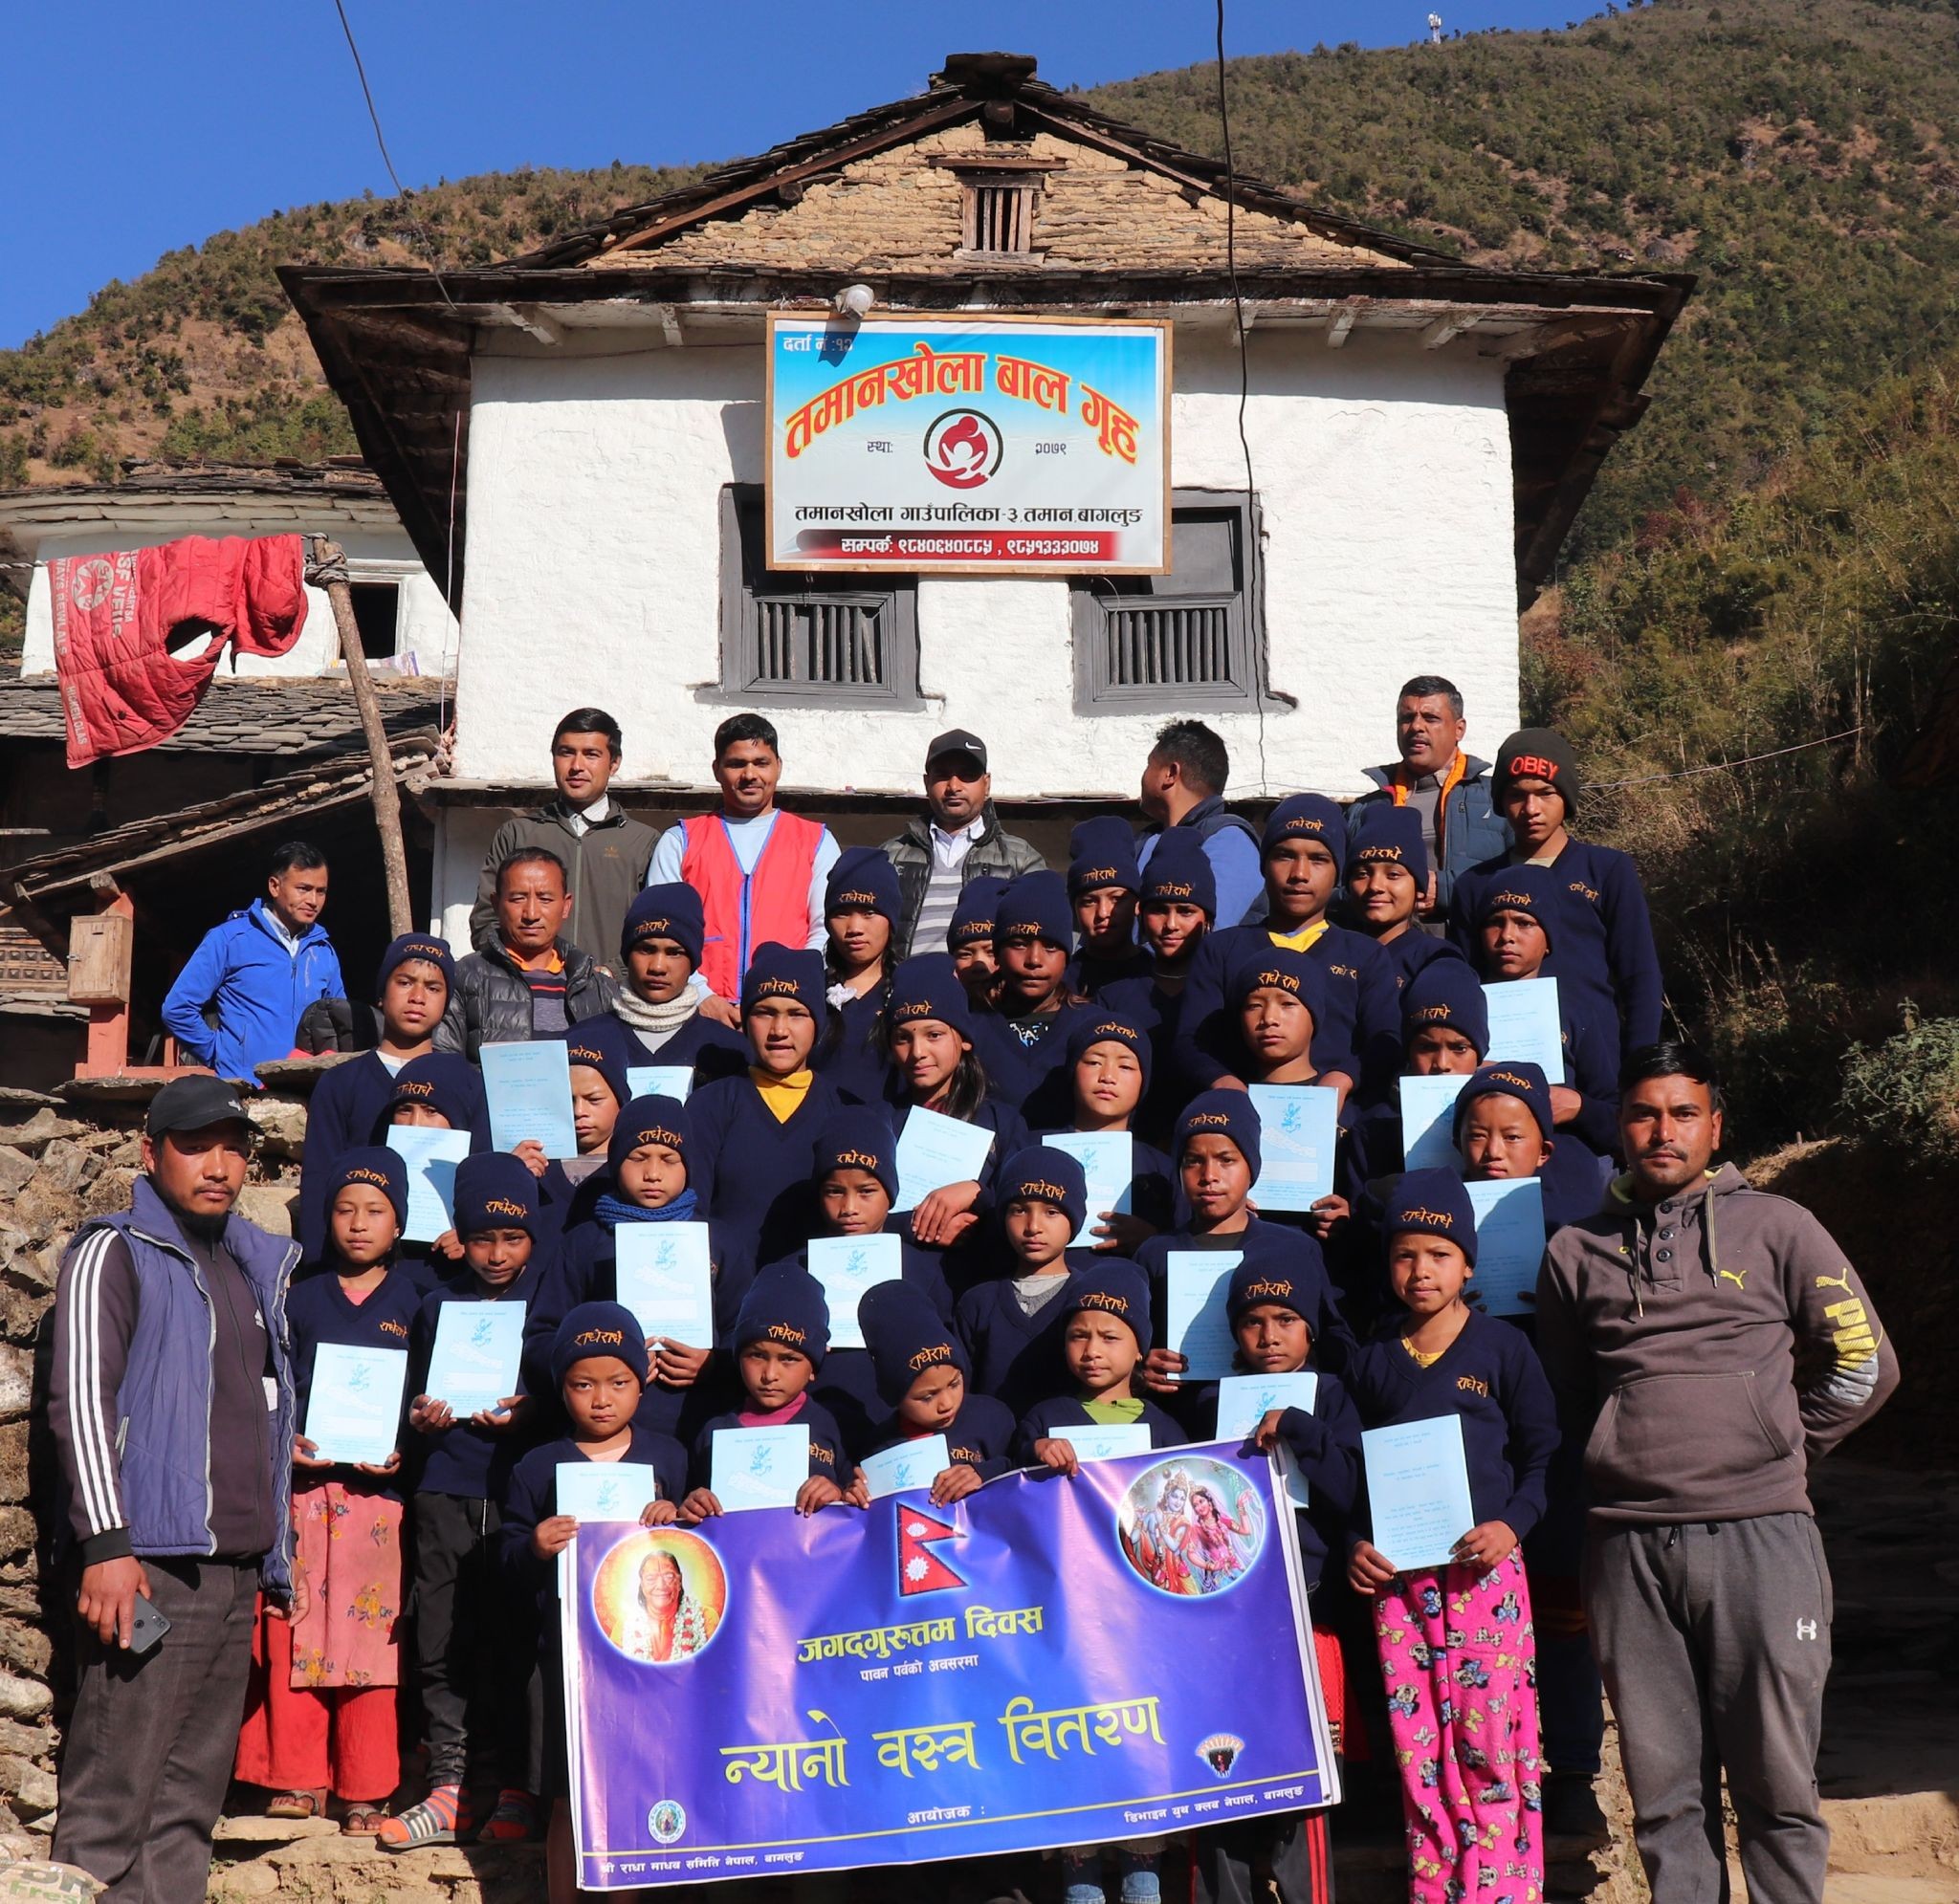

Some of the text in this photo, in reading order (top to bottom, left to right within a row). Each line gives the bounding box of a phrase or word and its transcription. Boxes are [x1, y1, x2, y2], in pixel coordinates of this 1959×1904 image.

[782, 334, 812, 352] दर्ता
[785, 341, 1140, 465] तमानखोला बाल गृह
[1035, 443, 1067, 455] २०७९
[795, 502, 894, 522] तमानखोला
[1077, 508, 1143, 527] बागलुङ
[841, 535, 893, 554] सम्पर्क:
[898, 538, 993, 556] ९८४०६४०८८५
[1006, 539, 1099, 556] ९८५१३३३०७४
[1510, 755, 1559, 781] OBEY
[964, 1606, 1044, 1639] दिवस
[719, 1696, 1167, 1792] न्यानो वस्त्र वितरण
[907, 1806, 972, 1825] आयोजक
[620, 1862, 646, 1874] राधा
